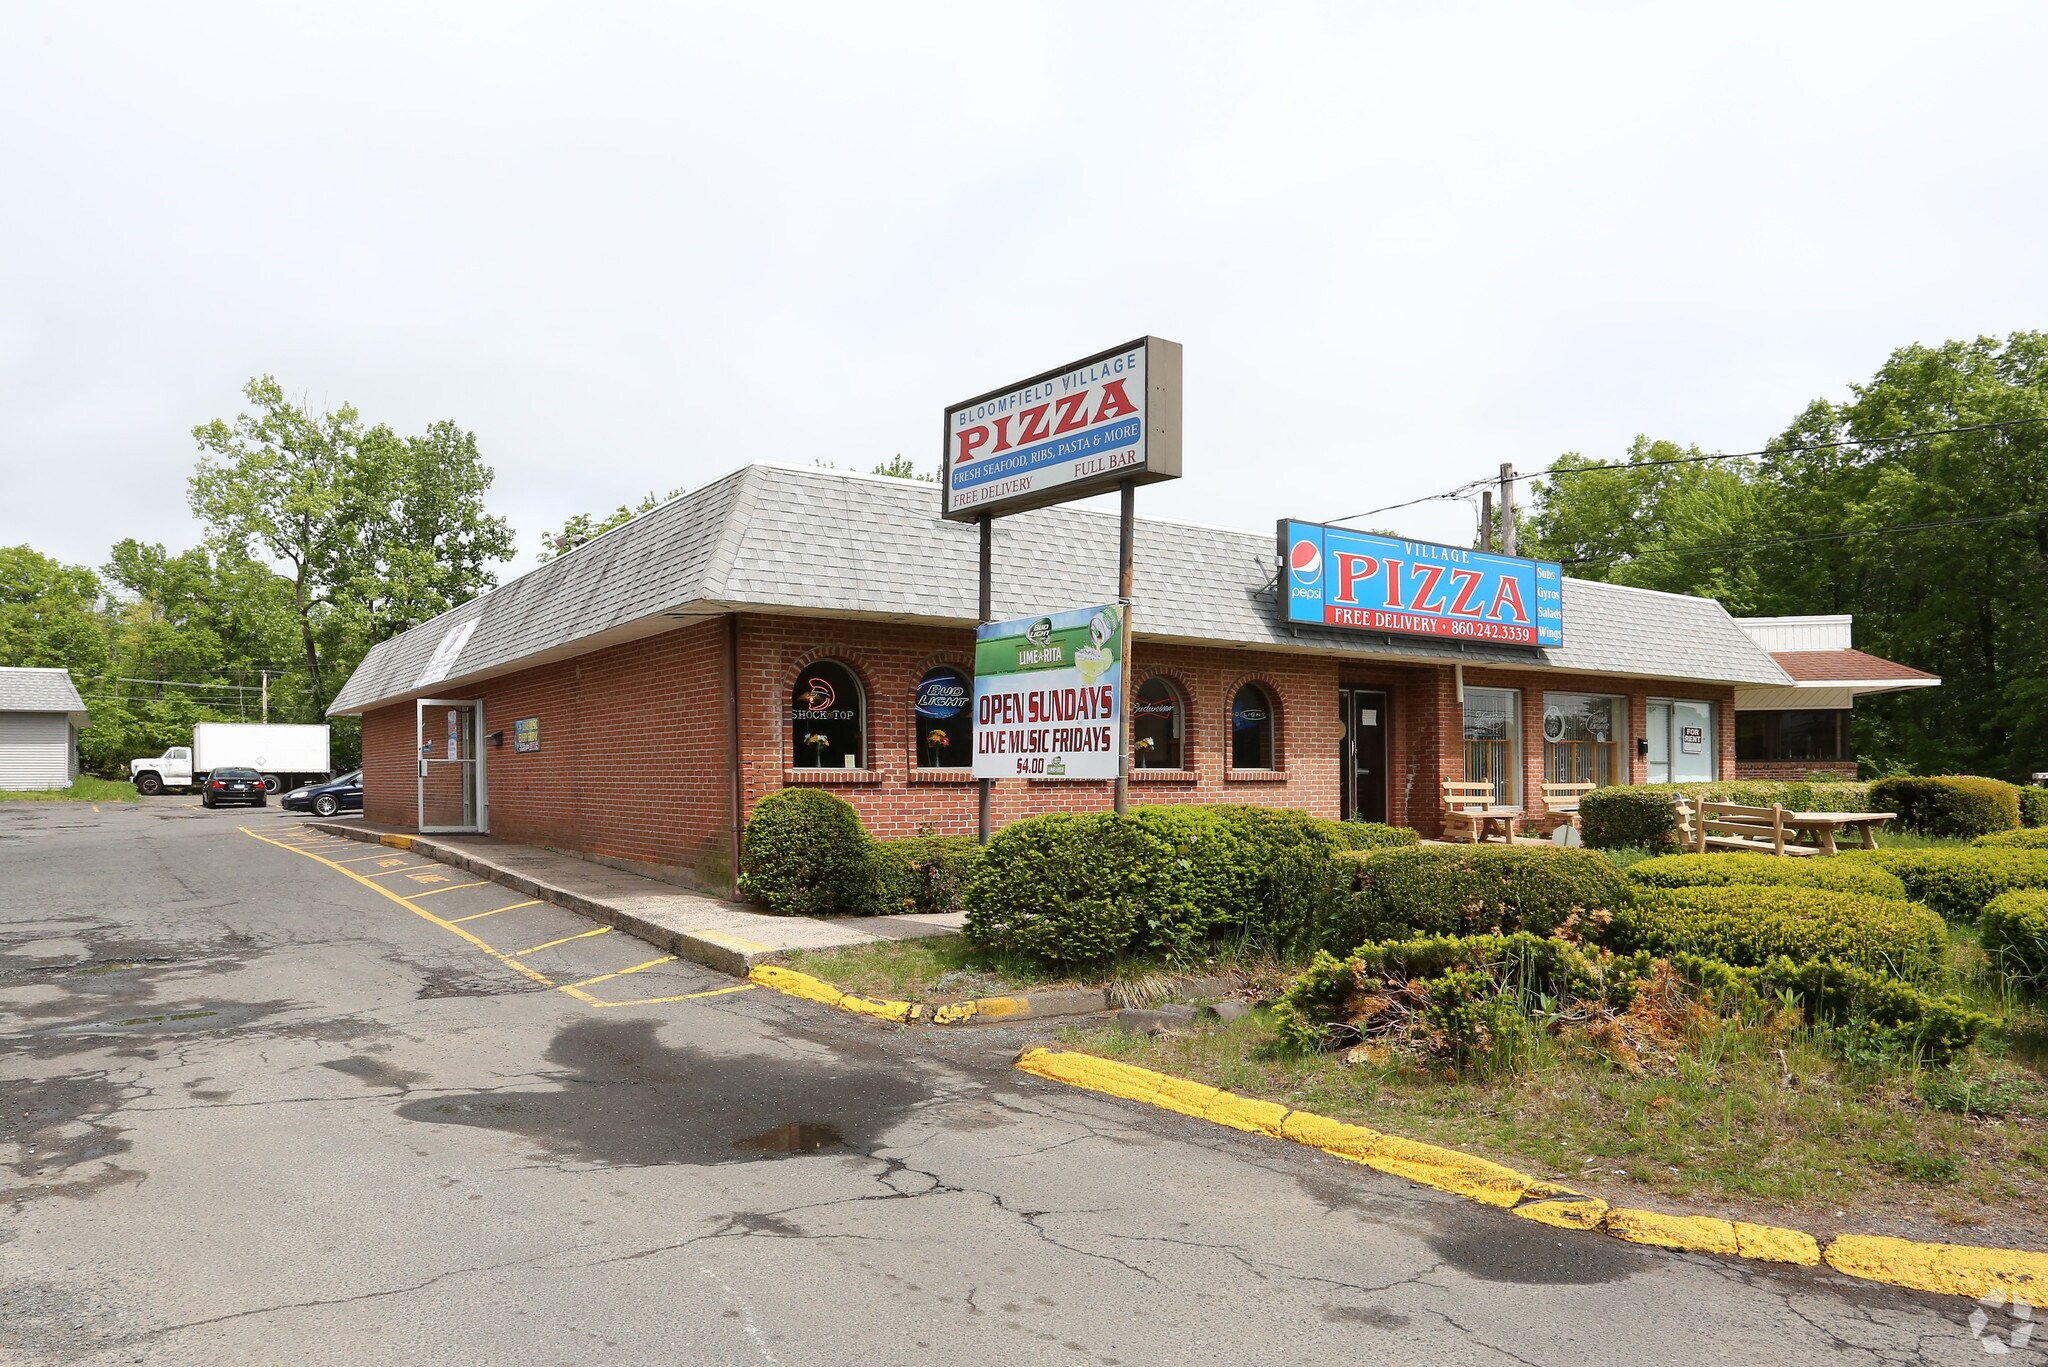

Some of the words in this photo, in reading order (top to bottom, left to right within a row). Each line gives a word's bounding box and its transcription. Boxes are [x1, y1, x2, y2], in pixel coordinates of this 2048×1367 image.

[959, 382, 1053, 426] BLOOMFIELD
[1062, 353, 1136, 391] VILLAGE
[955, 378, 1139, 464] PIZZA
[954, 465, 981, 484] FRESH
[983, 454, 1029, 475] SEAFOOD,
[1031, 447, 1056, 464] RIBS,
[1058, 438, 1090, 457] PASTA
[1093, 434, 1103, 446] &
[1104, 423, 1139, 443] MORE
[1074, 459, 1105, 477] FULL
[1109, 450, 1137, 469] BAR
[953, 489, 978, 507] FREE
[981, 476, 1033, 500] DELIVERY
[1404, 542, 1470, 564] VILLAGE
[1537, 567, 1556, 580] Subs
[1292, 587, 1321, 601] pepsi
[1334, 551, 1531, 623] PIZZA
[1537, 586, 1560, 601] Gyros
[1538, 606, 1562, 620] Salads
[1033, 623, 1049, 632] BUD
[1335, 608, 1371, 626] FREE
[1375, 612, 1438, 633] DELIVERY
[1451, 620, 1531, 642] 860.242.3339
[1030, 629, 1051, 638] LIGHT
[1538, 626, 1562, 642] Wings
[927, 684, 964, 697] BUD
[917, 697, 970, 708] LIGHT
[979, 692, 1025, 725] OPEN
[1028, 685, 1112, 723] SUNDAYS
[792, 710, 827, 720] SHOCK
[832, 710, 854, 720] TOP
[979, 731, 1006, 754] LIVE
[1008, 728, 1050, 753] MUSIC
[1052, 726, 1111, 752] FRIDAYS
[1684, 735, 1701, 743] RENT
[1686, 728, 1700, 736] FOR
[1016, 757, 1045, 775] $4.00
